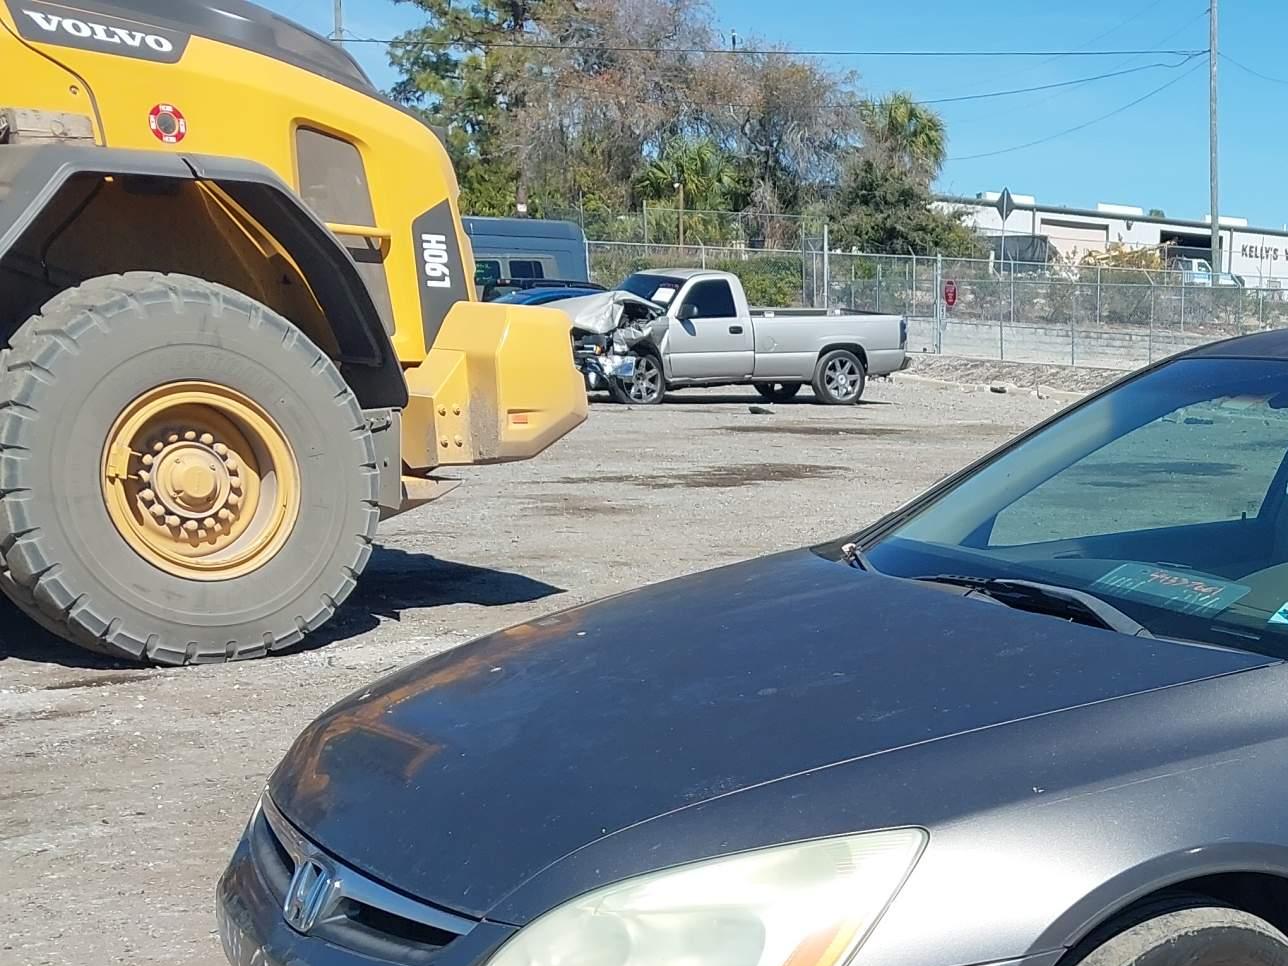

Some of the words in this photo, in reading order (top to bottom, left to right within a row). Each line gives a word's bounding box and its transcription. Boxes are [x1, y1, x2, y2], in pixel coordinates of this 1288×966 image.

[22, 9, 173, 52] VOLVO
[421, 233, 451, 288] L90H
[1241, 244, 1279, 260] KELLY'S
